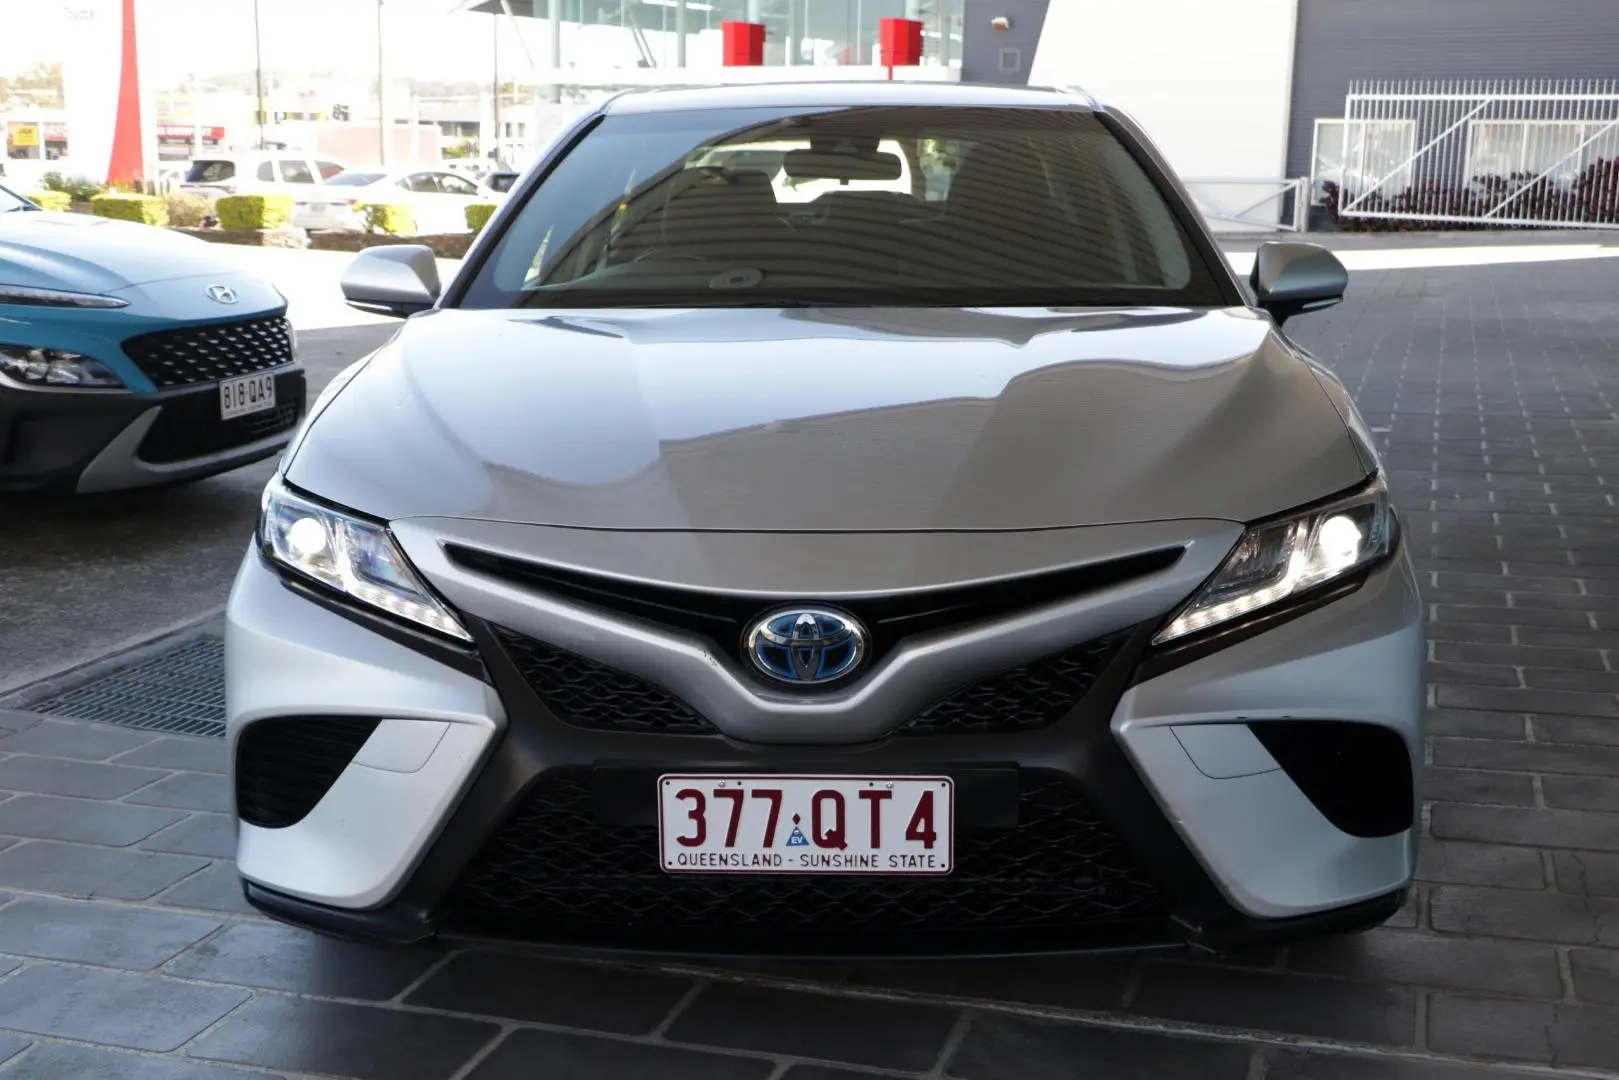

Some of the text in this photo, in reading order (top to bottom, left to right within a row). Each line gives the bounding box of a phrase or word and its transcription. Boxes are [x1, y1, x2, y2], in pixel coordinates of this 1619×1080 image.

[675, 788, 937, 850] 377 QT4
[791, 835, 804, 844] EV
[677, 853, 782, 867] QUEENSLAND
[800, 854, 879, 868] SUNSHINE
[888, 855, 936, 868] STATE
